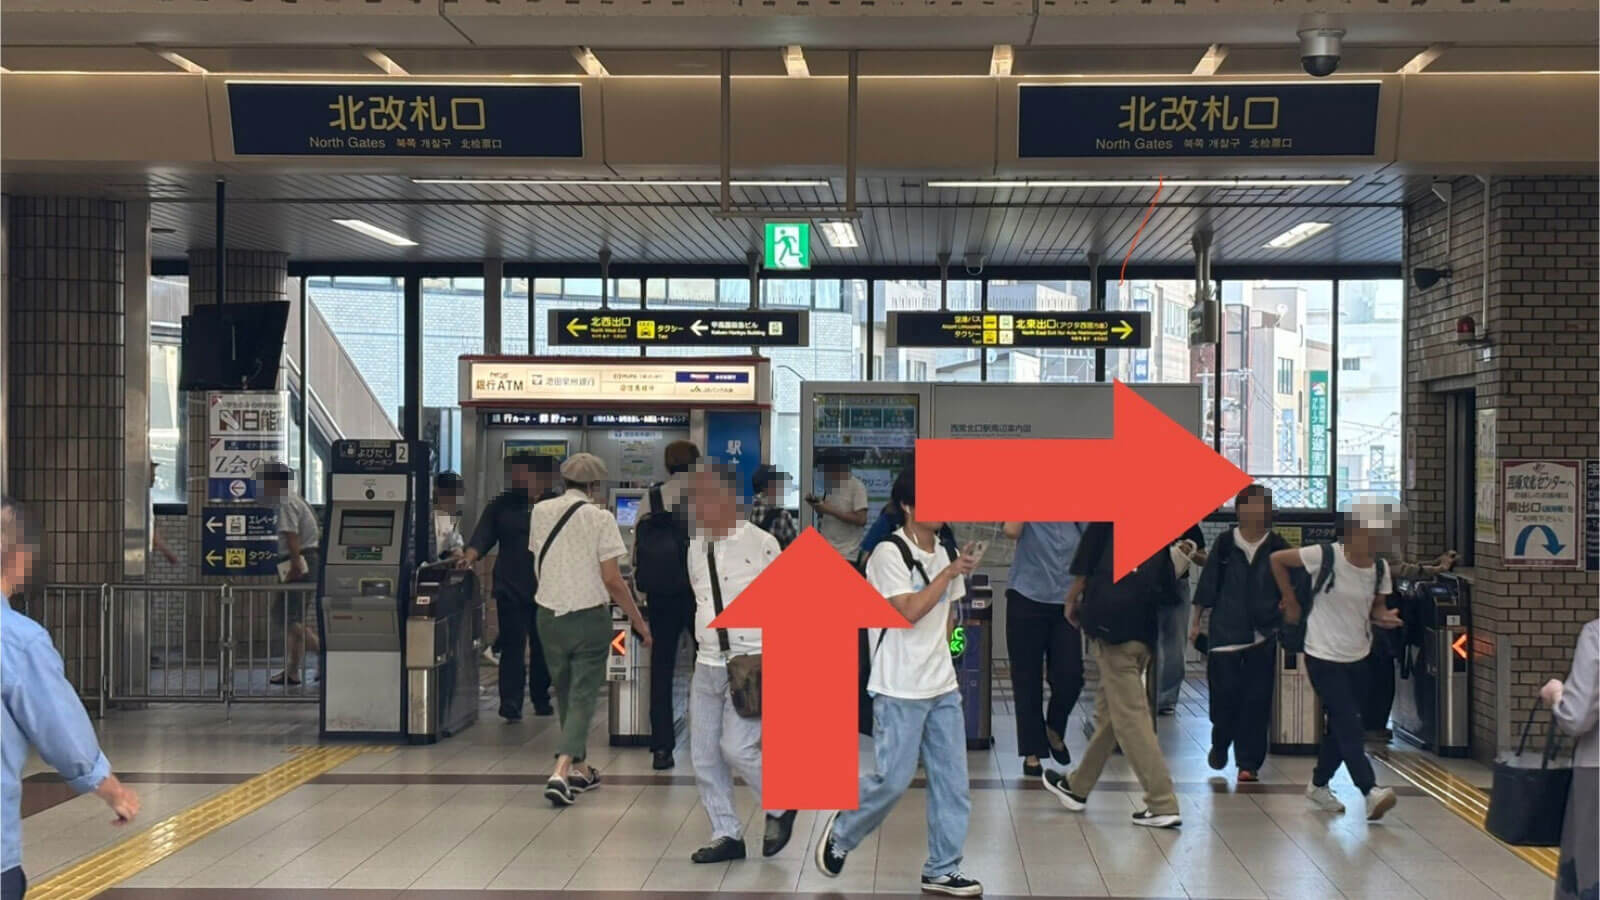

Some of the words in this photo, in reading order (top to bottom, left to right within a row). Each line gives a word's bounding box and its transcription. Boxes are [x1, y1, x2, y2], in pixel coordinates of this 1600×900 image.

[328, 95, 486, 131] 北改札口
[1118, 95, 1279, 132] 北改札口
[309, 136, 344, 148] North
[347, 136, 386, 148] Gates
[1096, 137, 1130, 149] North
[1134, 137, 1173, 149] Gates
[591, 317, 631, 327] 北西出口
[476, 380, 524, 391] 銀行ATM
[219, 410, 282, 431] N日能
[357, 448, 393, 458] よびだし
[398, 446, 406, 460] 2
[215, 455, 280, 473] Z会の
[249, 551, 278, 561] タクシー
